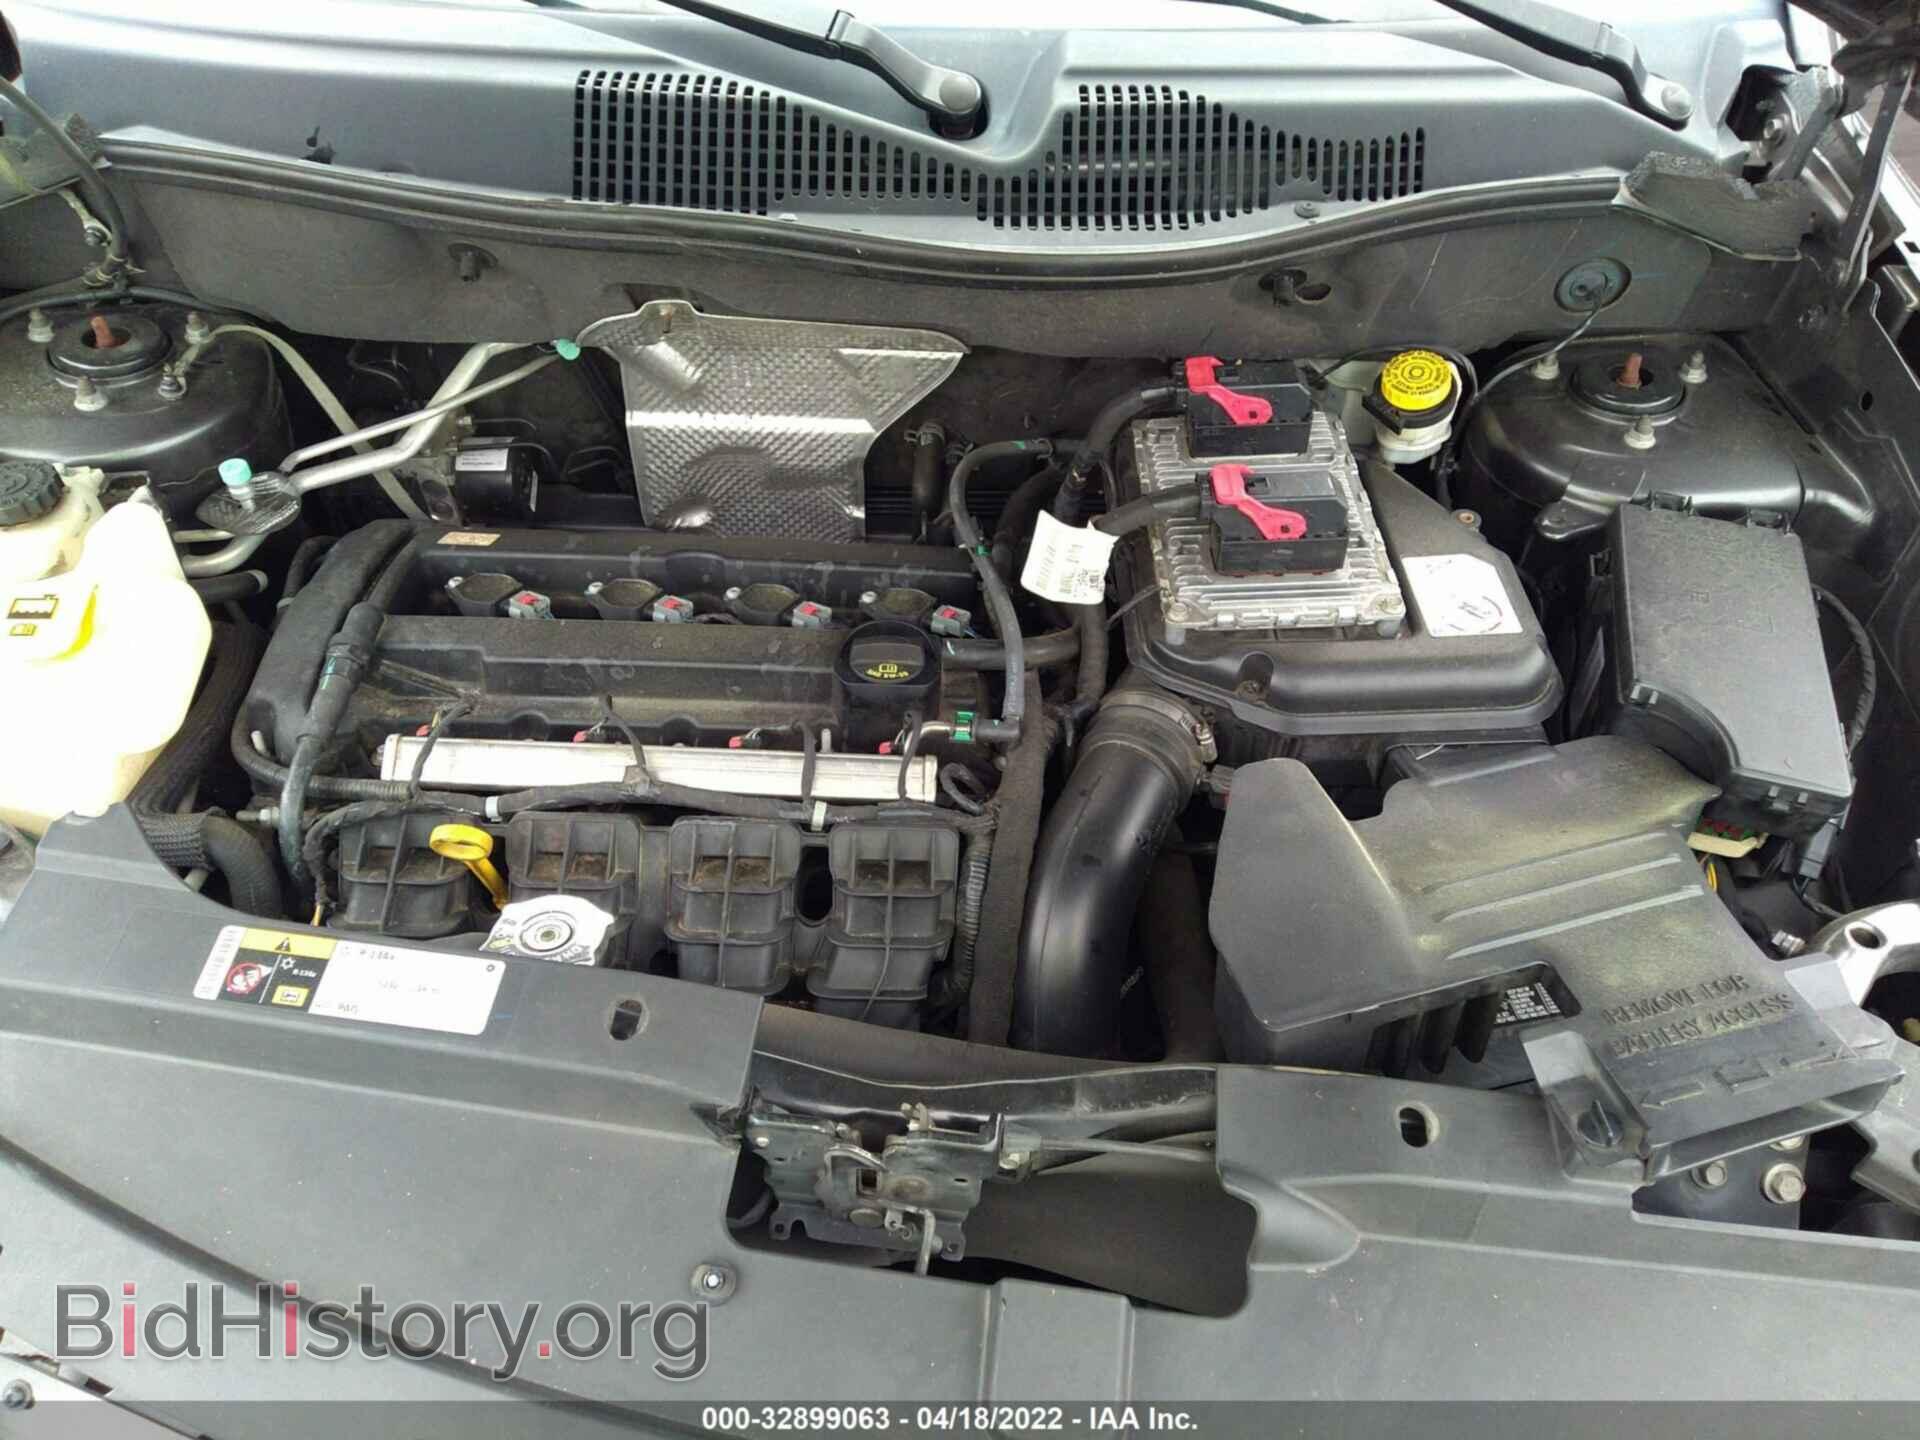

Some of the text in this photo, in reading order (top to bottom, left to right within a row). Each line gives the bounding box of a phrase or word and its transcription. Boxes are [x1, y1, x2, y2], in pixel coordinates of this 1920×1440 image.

[1600, 974, 1751, 1026] REMOVE FOR
[1706, 991, 1794, 1032] ACCESS
